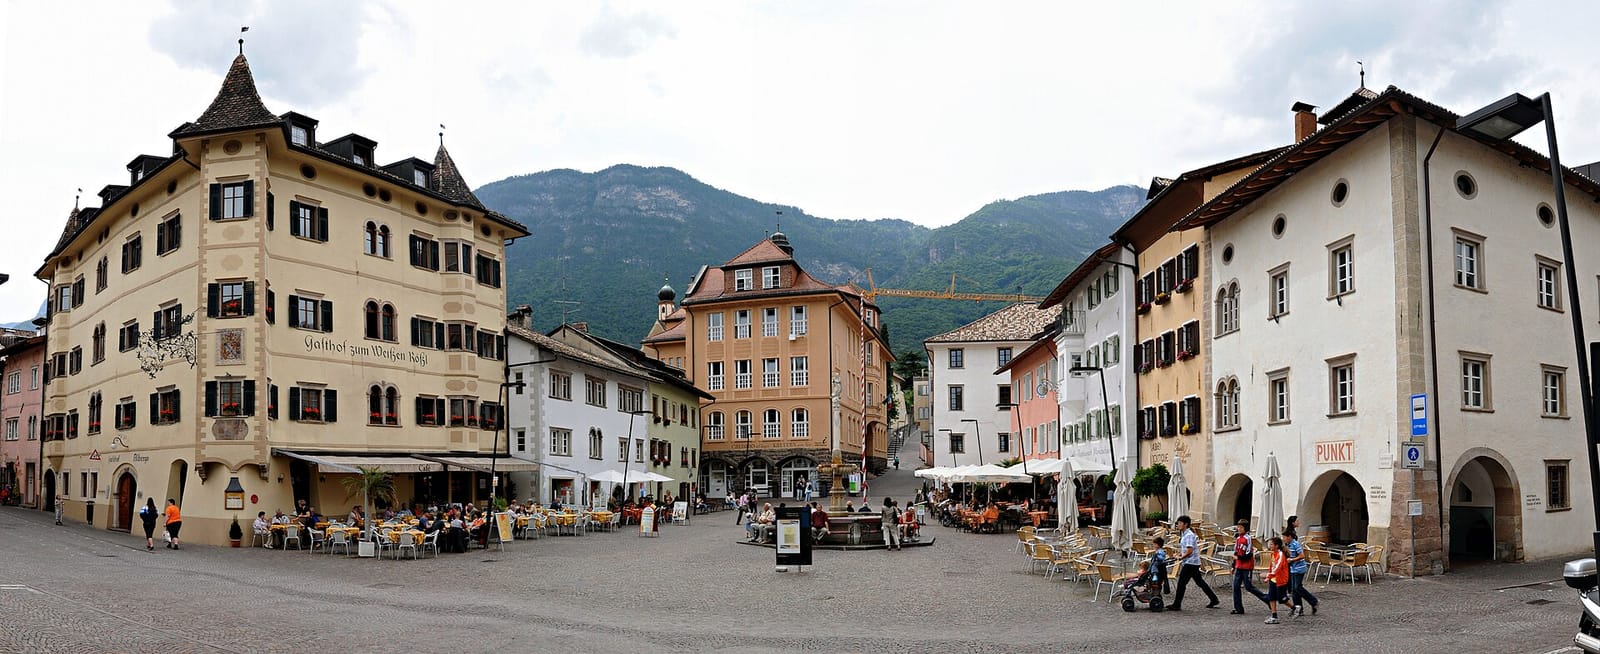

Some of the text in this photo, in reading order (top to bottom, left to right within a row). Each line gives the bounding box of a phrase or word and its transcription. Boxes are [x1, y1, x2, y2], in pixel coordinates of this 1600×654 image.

[304, 334, 347, 354] Gasthof
[349, 345, 369, 357] zum
[371, 344, 406, 363] Weißen
[1317, 442, 1353, 462] PUNKT
